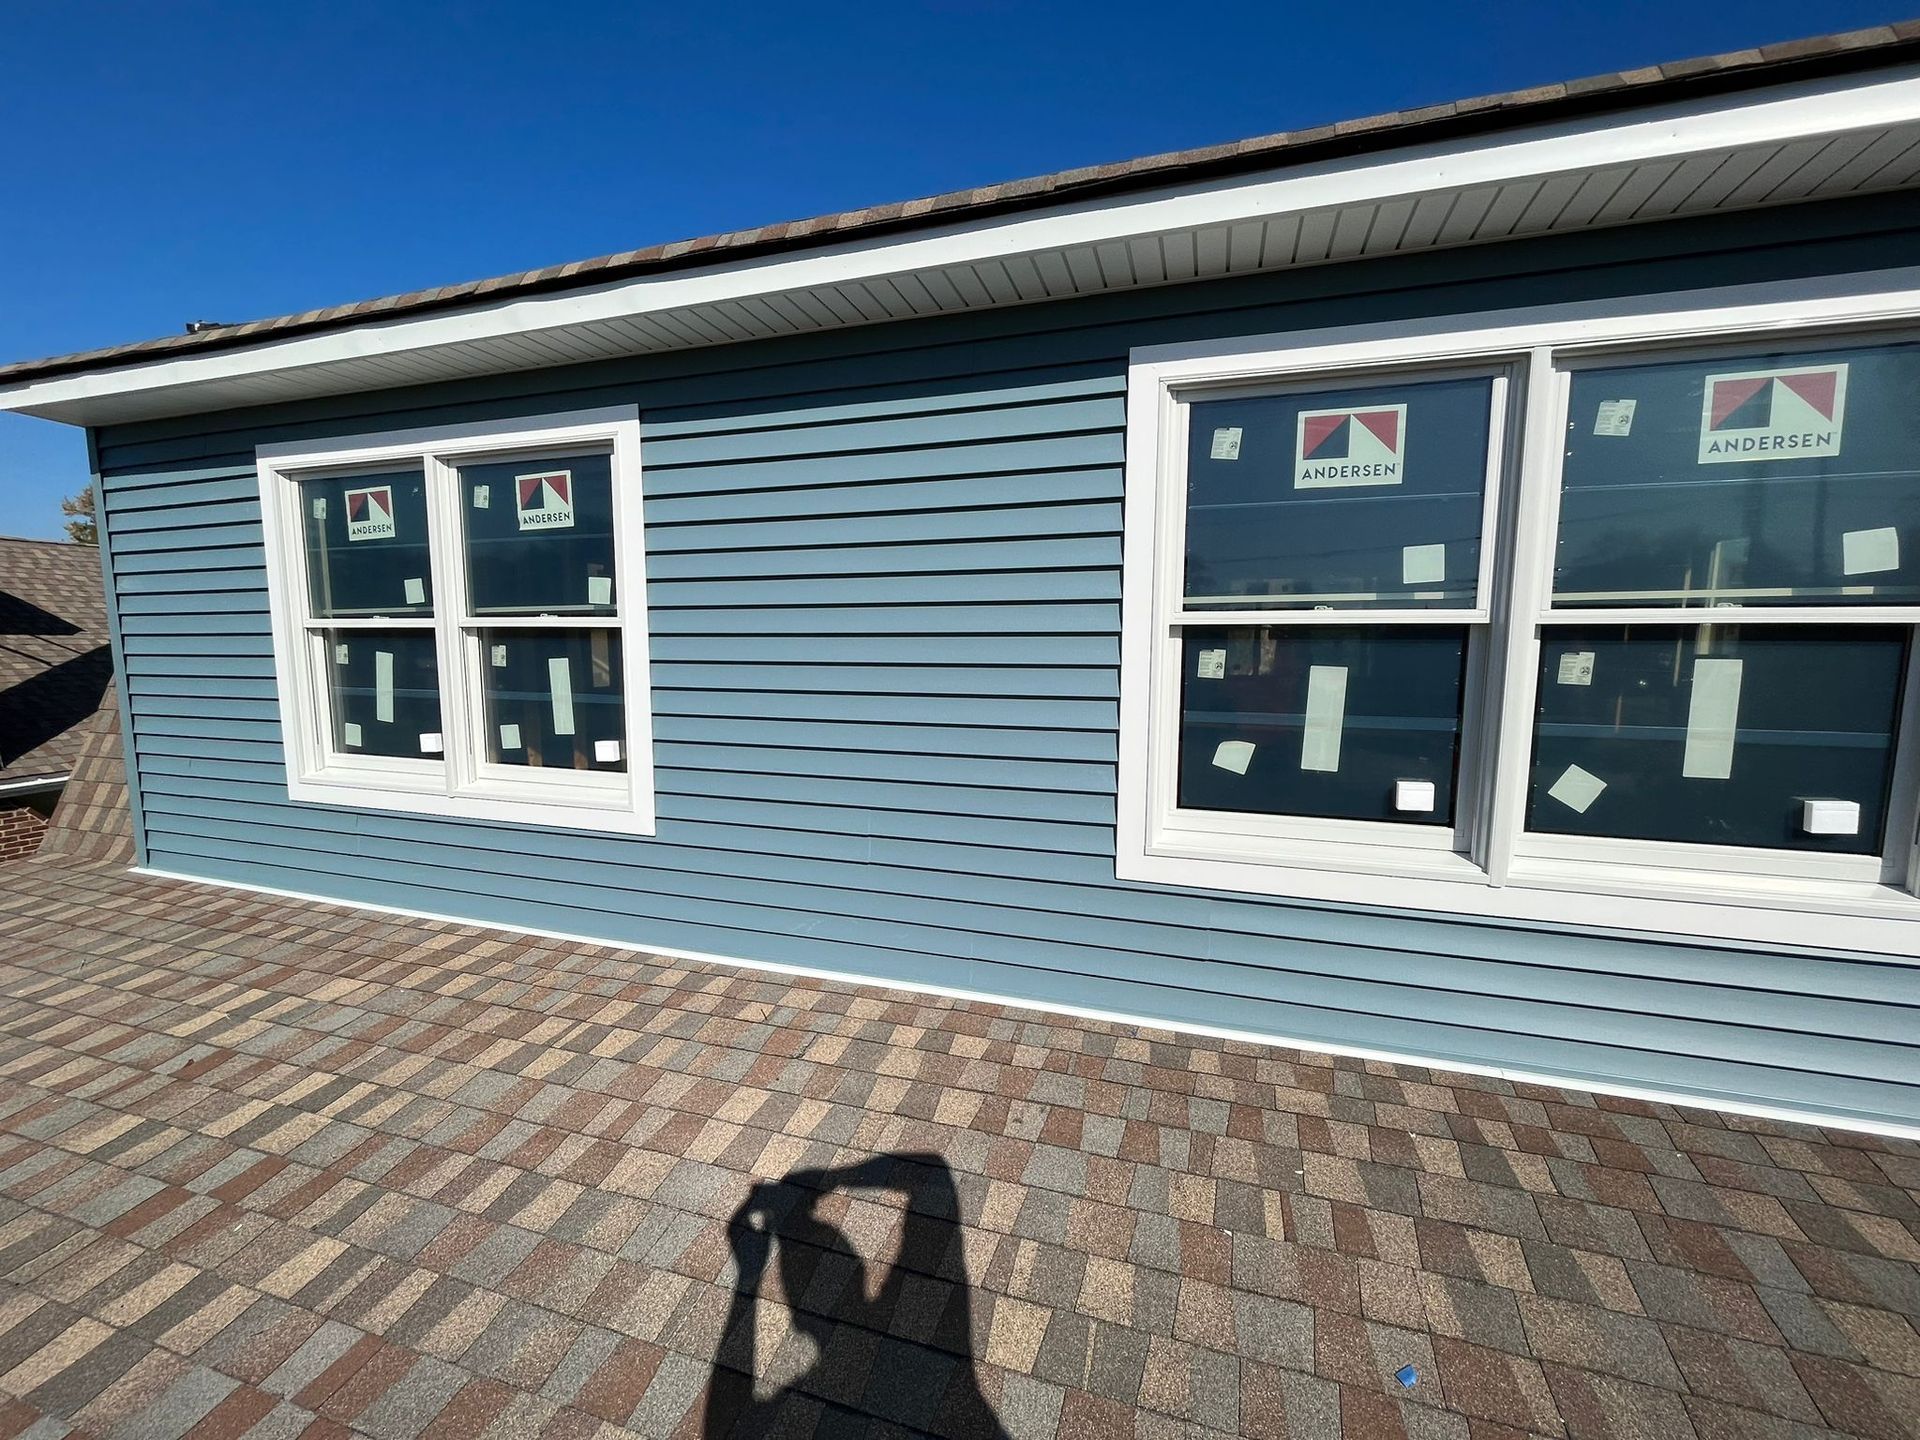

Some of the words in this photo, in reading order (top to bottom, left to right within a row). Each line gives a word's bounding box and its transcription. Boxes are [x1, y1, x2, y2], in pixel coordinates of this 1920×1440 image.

[1708, 432, 1831, 453] ANDERSEN
[1301, 463, 1396, 480] ANDERSEN
[523, 511, 570, 525] ANDERSEN
[352, 524, 392, 535] ANDERSEN
